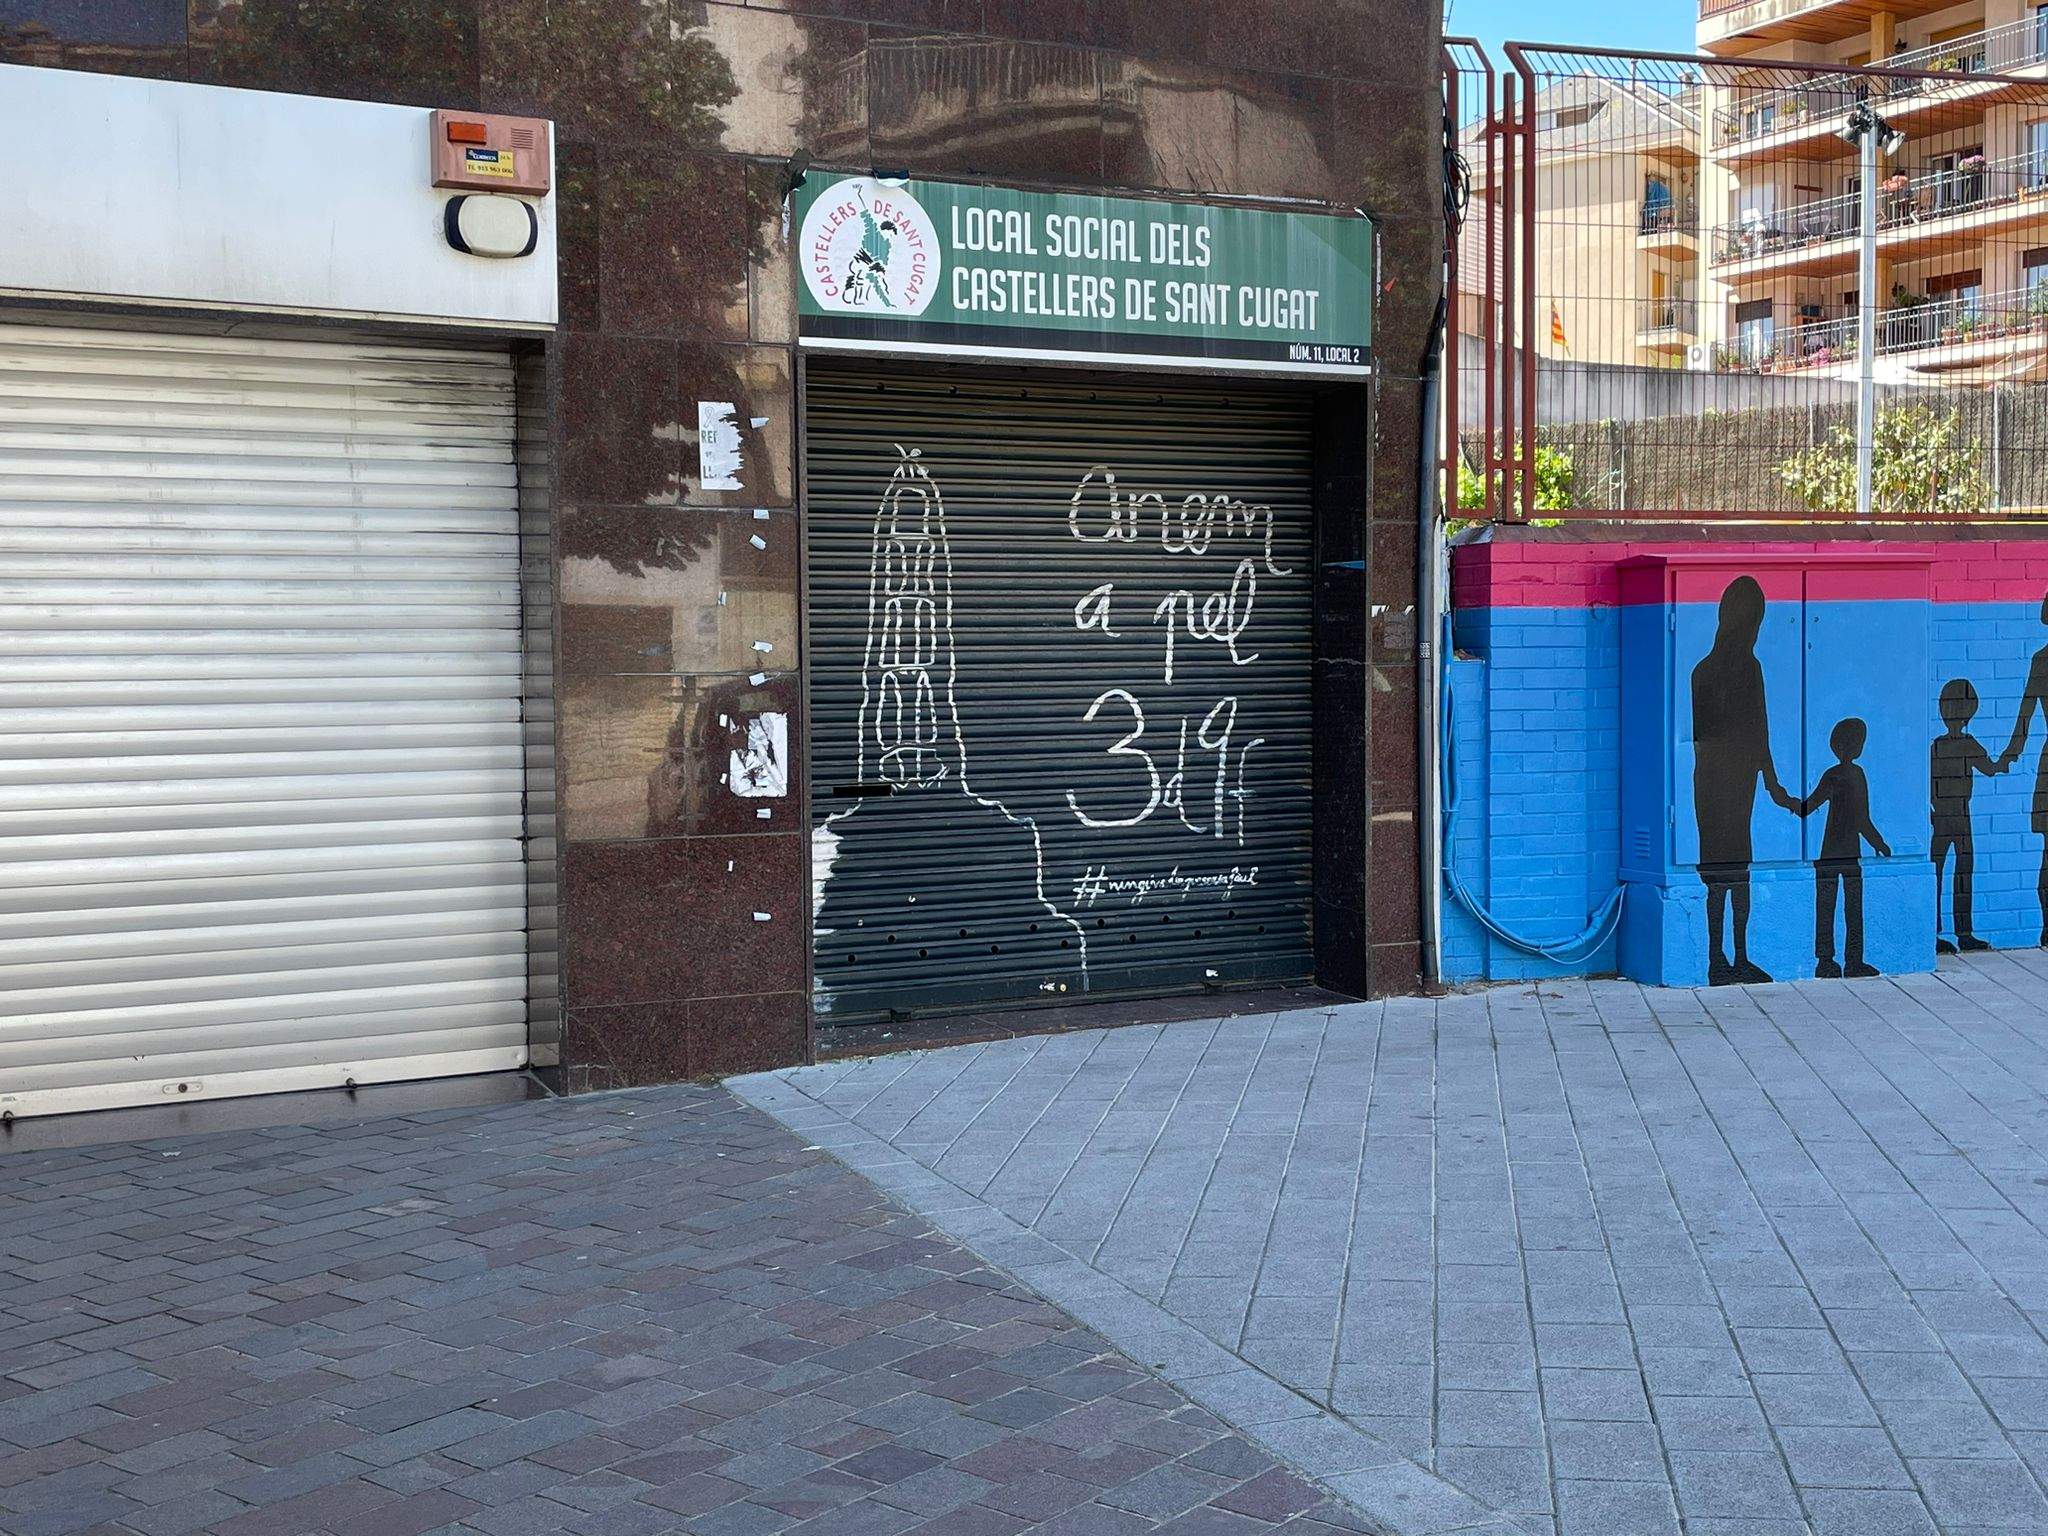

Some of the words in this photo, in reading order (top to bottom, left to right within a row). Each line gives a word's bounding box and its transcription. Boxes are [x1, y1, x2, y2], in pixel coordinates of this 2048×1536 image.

[874, 199, 892, 218] DE
[893, 211, 923, 249] SANT
[952, 205, 1038, 255] LOCAL
[1046, 214, 1141, 262] SOCIAL
[1150, 222, 1211, 267] DELS
[815, 202, 857, 297] CASTELLERS
[904, 252, 926, 306] CUGAT
[952, 266, 1116, 319] CASTELLERS
[1125, 278, 1157, 321] DE
[1165, 281, 1231, 325] SANT
[1239, 286, 1319, 330] CUGAT
[1289, 342, 1312, 361] NÚM.
[1313, 346, 1324, 363] 11,
[1326, 346, 1352, 362] LOCAL
[1353, 348, 1360, 363] 2
[1153, 558, 1259, 686] pel
